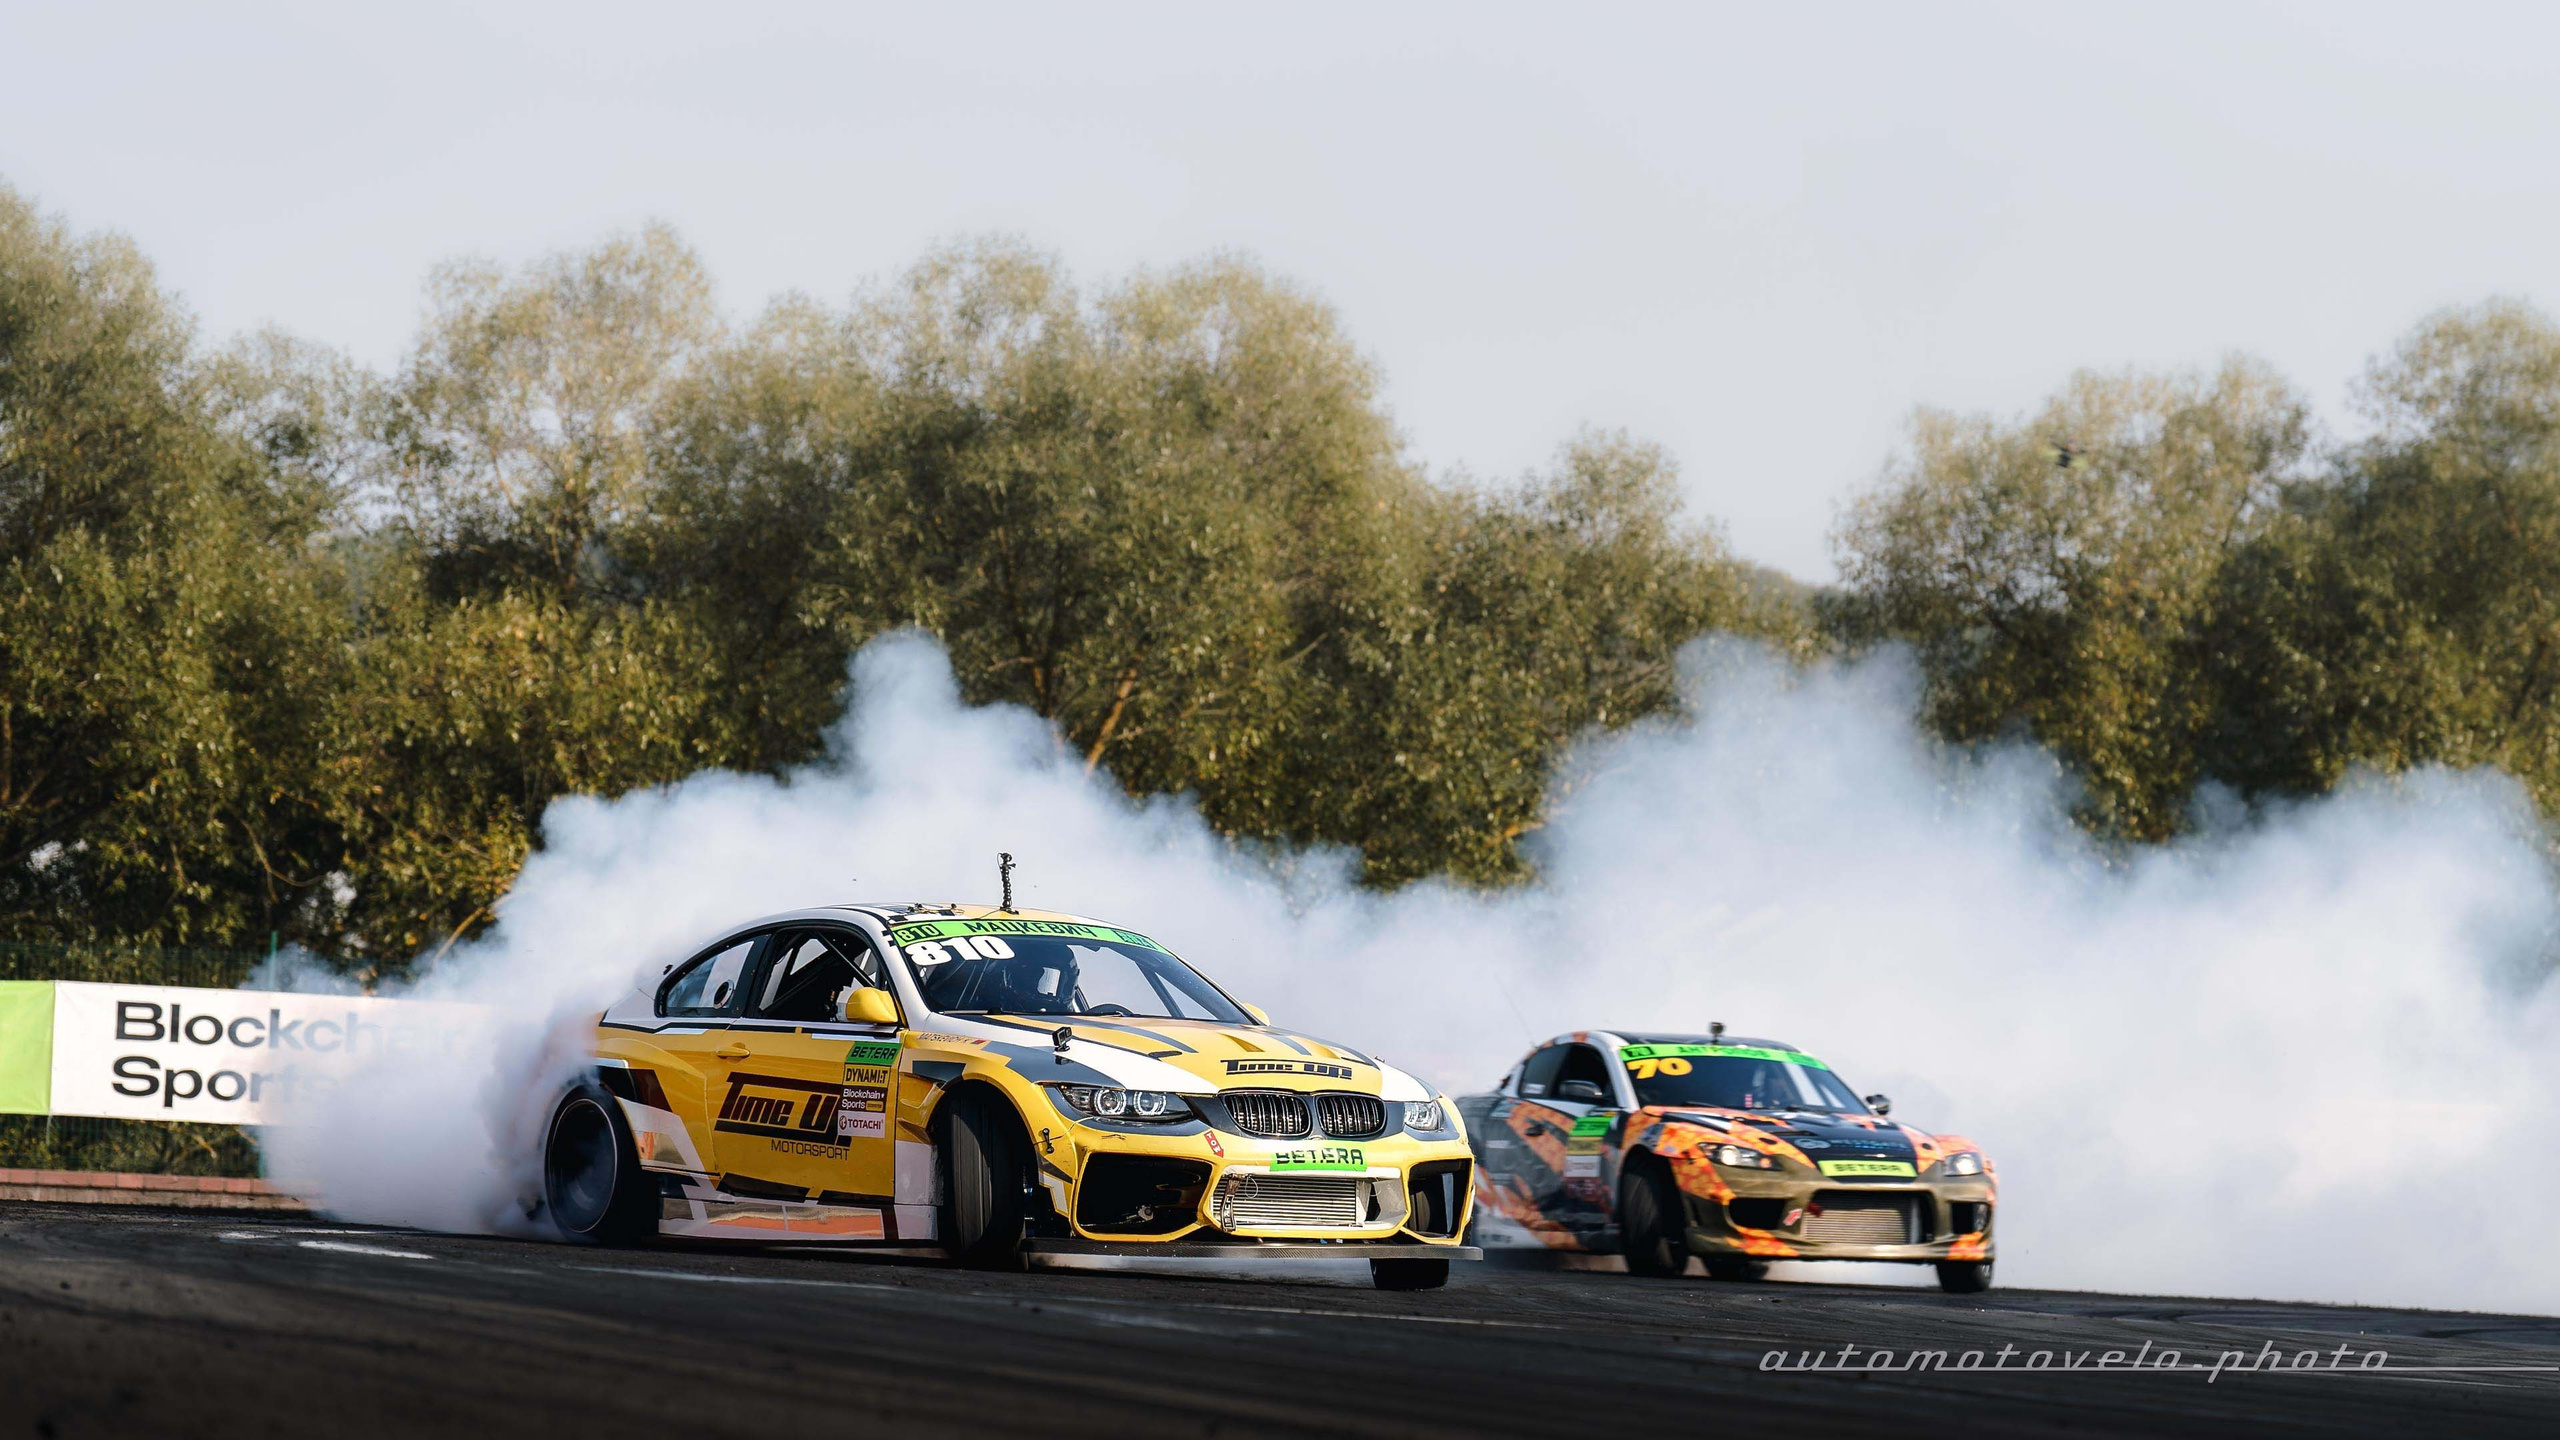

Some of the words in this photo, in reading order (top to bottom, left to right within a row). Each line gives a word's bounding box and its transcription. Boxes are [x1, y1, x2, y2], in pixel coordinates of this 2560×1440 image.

[897, 924, 940, 941] 810
[963, 921, 1098, 938] МАЦКЕВИЧ
[904, 935, 1016, 966] 810
[114, 1000, 467, 1052] Blockcha
[1626, 1057, 1693, 1079] 70
[111, 1055, 339, 1108] Sport
[842, 1088, 881, 1100] Blockchain
[841, 1099, 866, 1110] Sports
[847, 1118, 881, 1130] TOTACHI
[771, 1138, 850, 1161] MOTORSPORT
